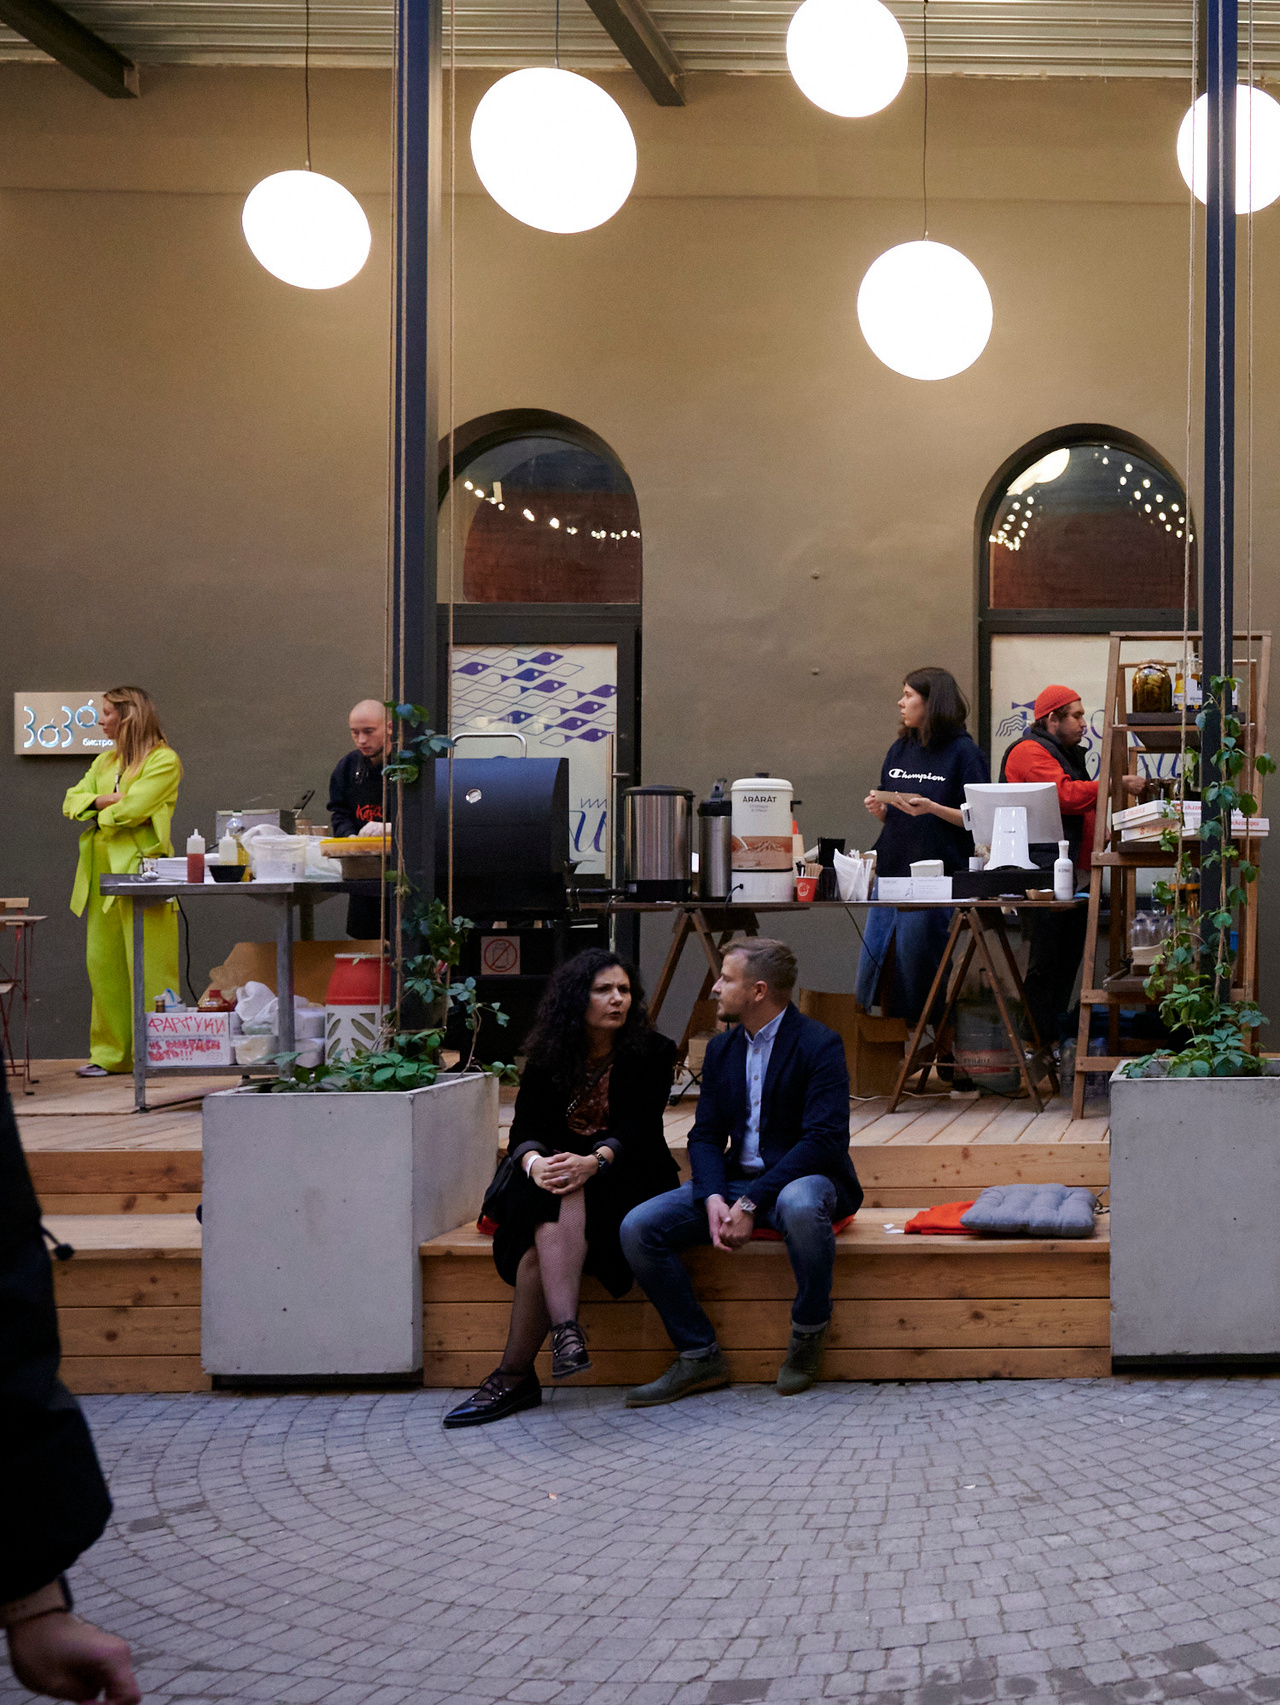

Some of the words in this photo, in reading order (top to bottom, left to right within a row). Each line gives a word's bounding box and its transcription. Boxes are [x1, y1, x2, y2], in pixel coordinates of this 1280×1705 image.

[82, 737, 113, 746] бистро
[888, 768, 946, 783] Champion
[742, 795, 777, 803] ARARAT
[147, 1015, 226, 1034] ФАРТУКИ
